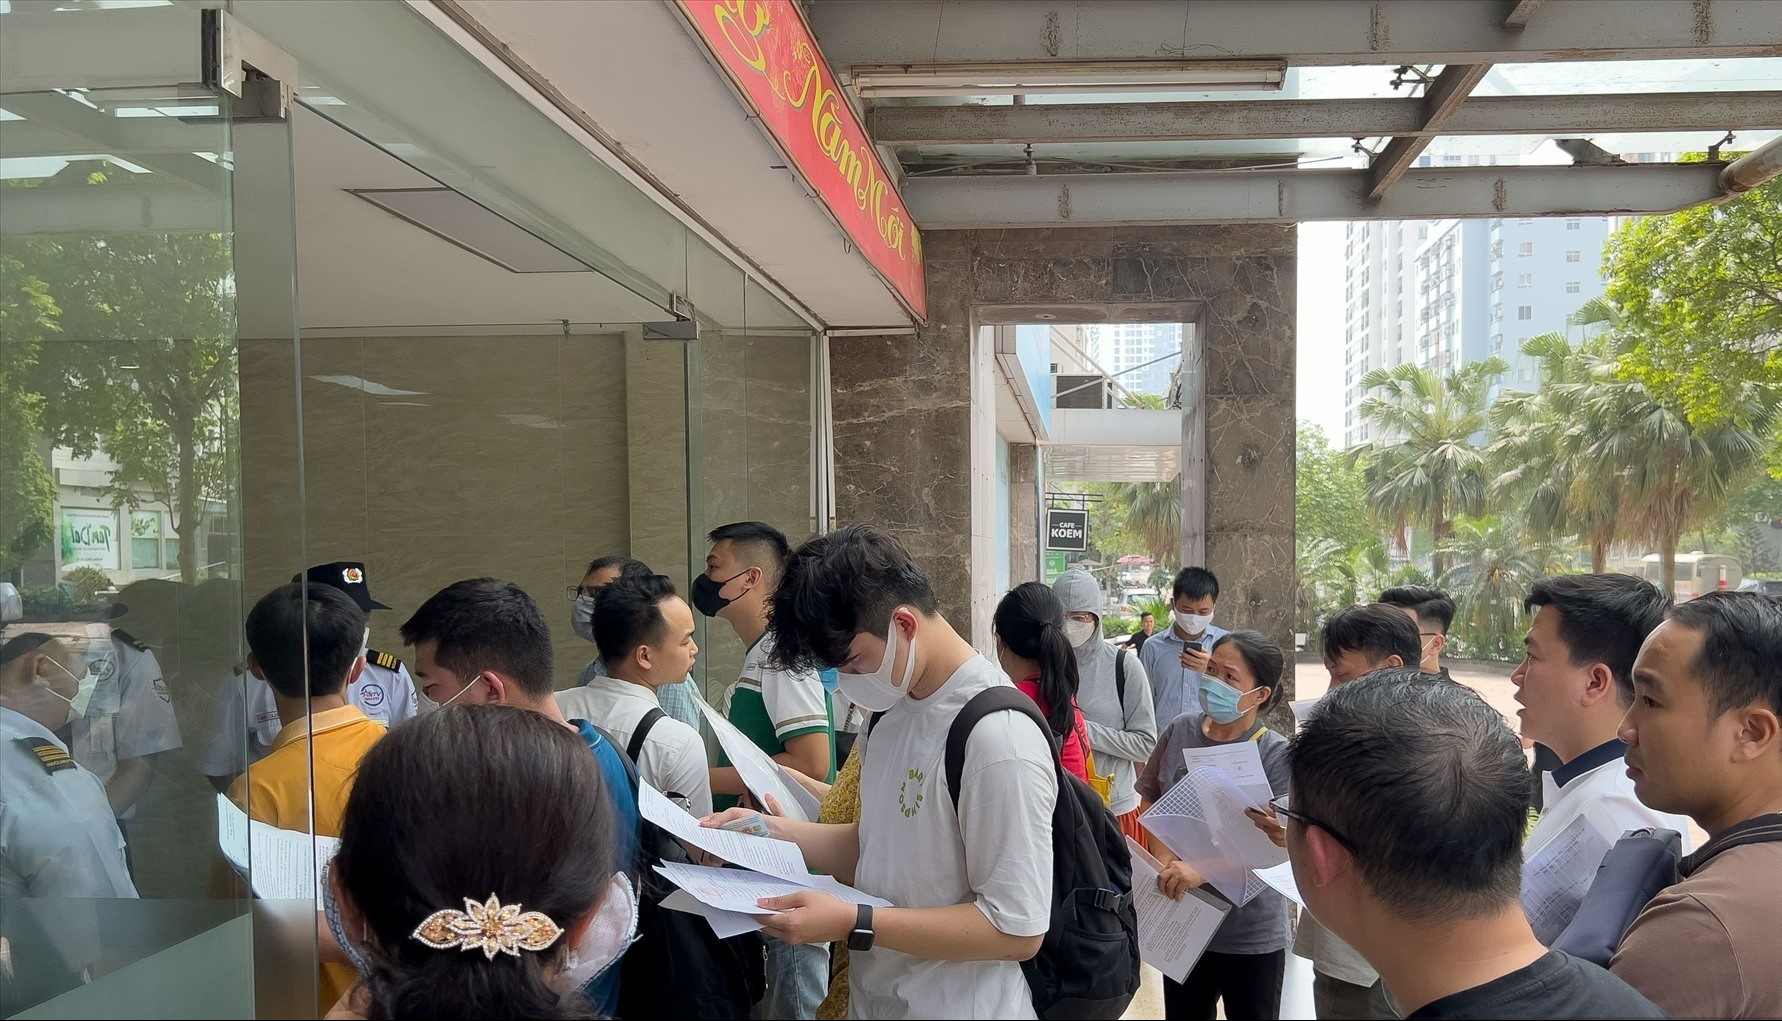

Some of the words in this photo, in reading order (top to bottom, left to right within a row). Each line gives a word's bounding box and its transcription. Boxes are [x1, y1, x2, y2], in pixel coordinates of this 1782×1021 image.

[783, 42, 866, 212] Năm
[858, 146, 905, 260] Mới
[1051, 528, 1082, 539] KOEM
